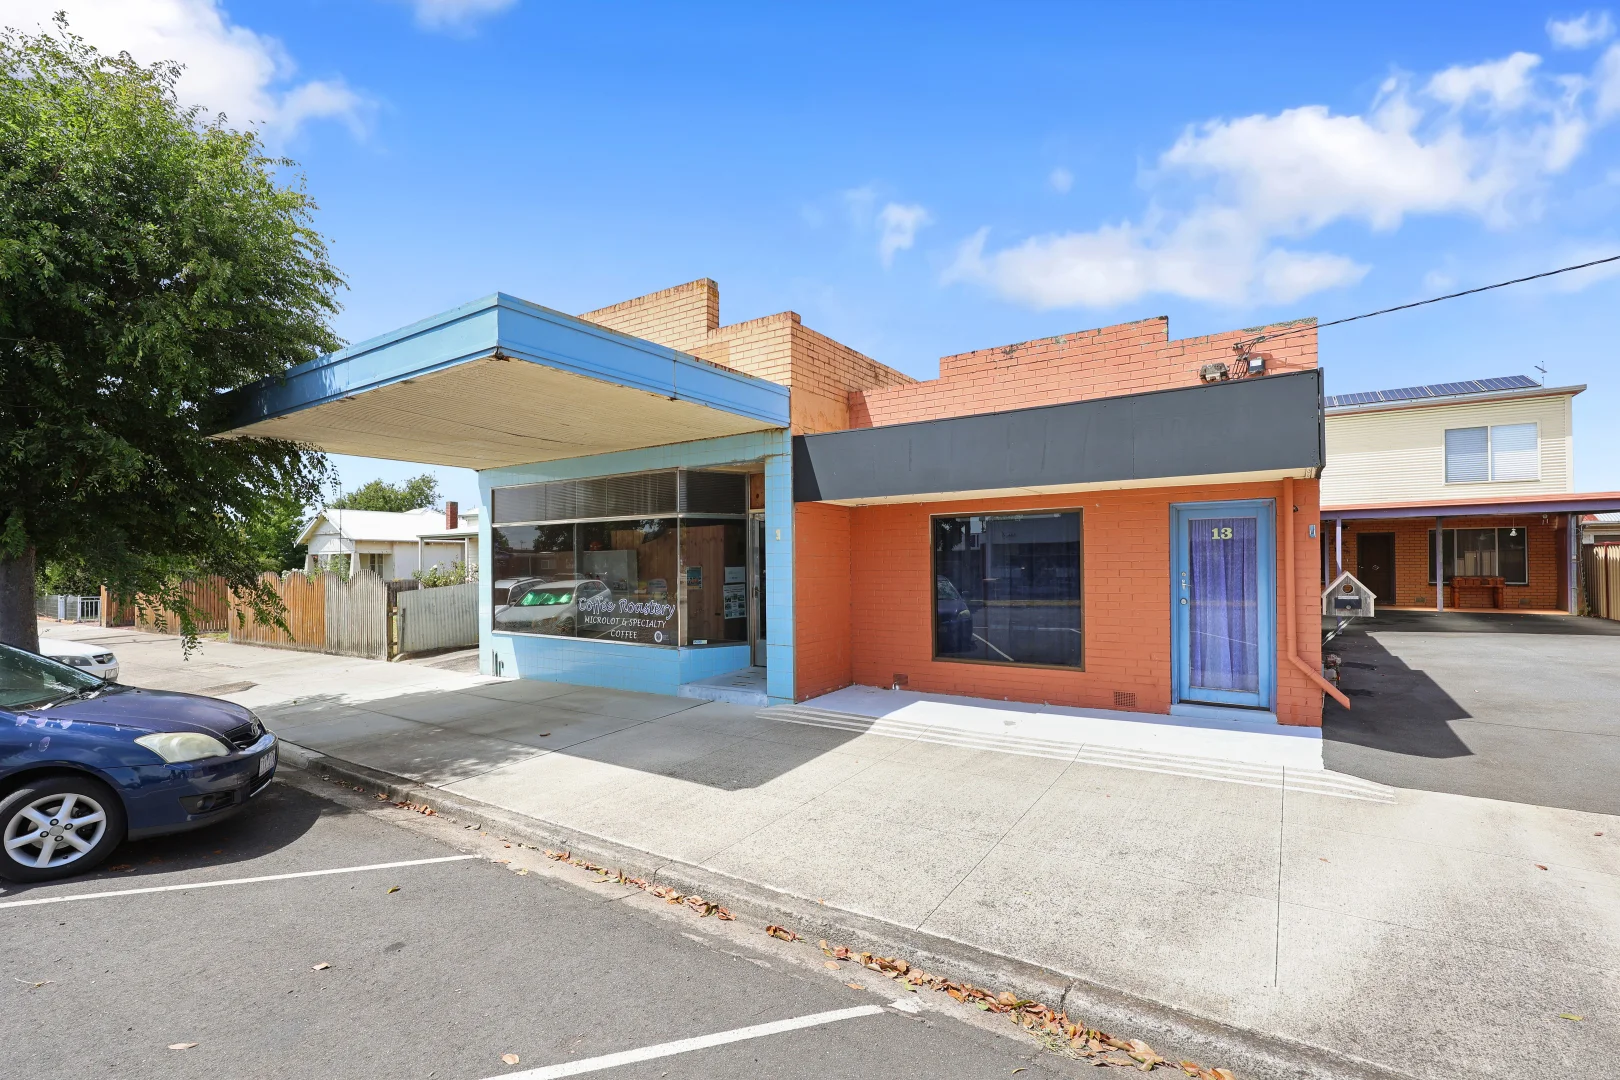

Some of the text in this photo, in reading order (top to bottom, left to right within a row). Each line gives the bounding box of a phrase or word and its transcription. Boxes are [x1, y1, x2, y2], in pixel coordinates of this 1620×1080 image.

[1211, 527, 1233, 540] 13
[578, 596, 676, 620] Coffee Roastery
[584, 615, 667, 628] MICROLOT & SPECIALTY
[610, 629, 638, 639] COFFEE
